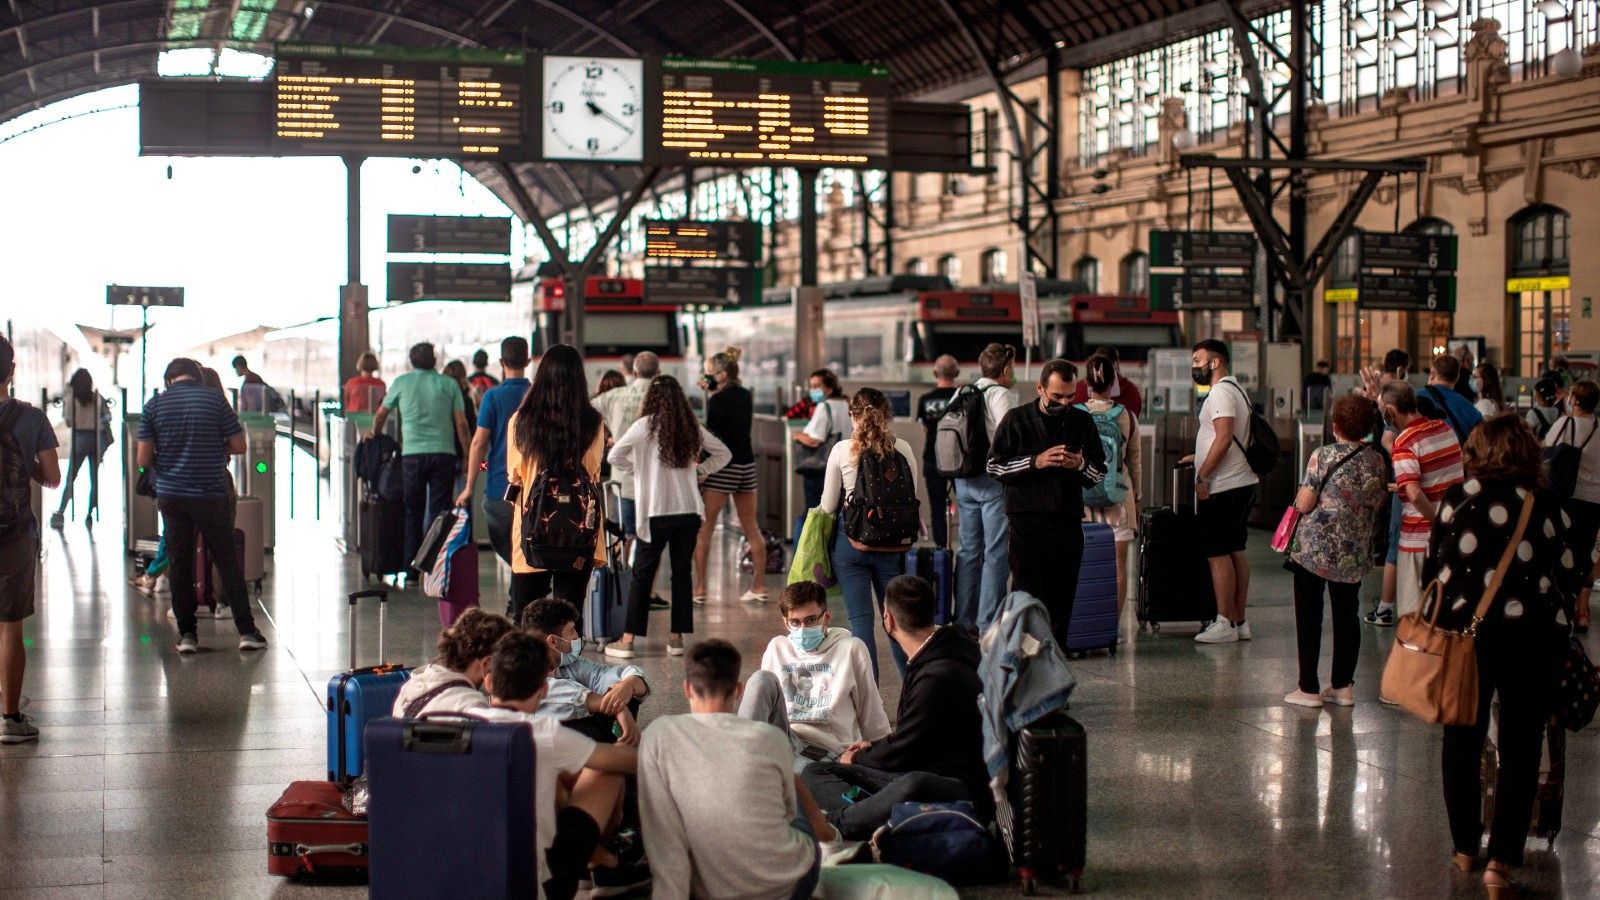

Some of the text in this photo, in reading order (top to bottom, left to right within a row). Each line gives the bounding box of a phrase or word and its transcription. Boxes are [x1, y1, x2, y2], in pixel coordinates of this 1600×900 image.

[585, 66, 604, 80] 12
[551, 101, 564, 114] 9
[621, 103, 634, 117] 3
[587, 137, 599, 151] 6
[1173, 248, 1184, 266] 5
[1428, 252, 1439, 270] 6
[1172, 291, 1183, 310] 5
[1427, 293, 1438, 311] 6
